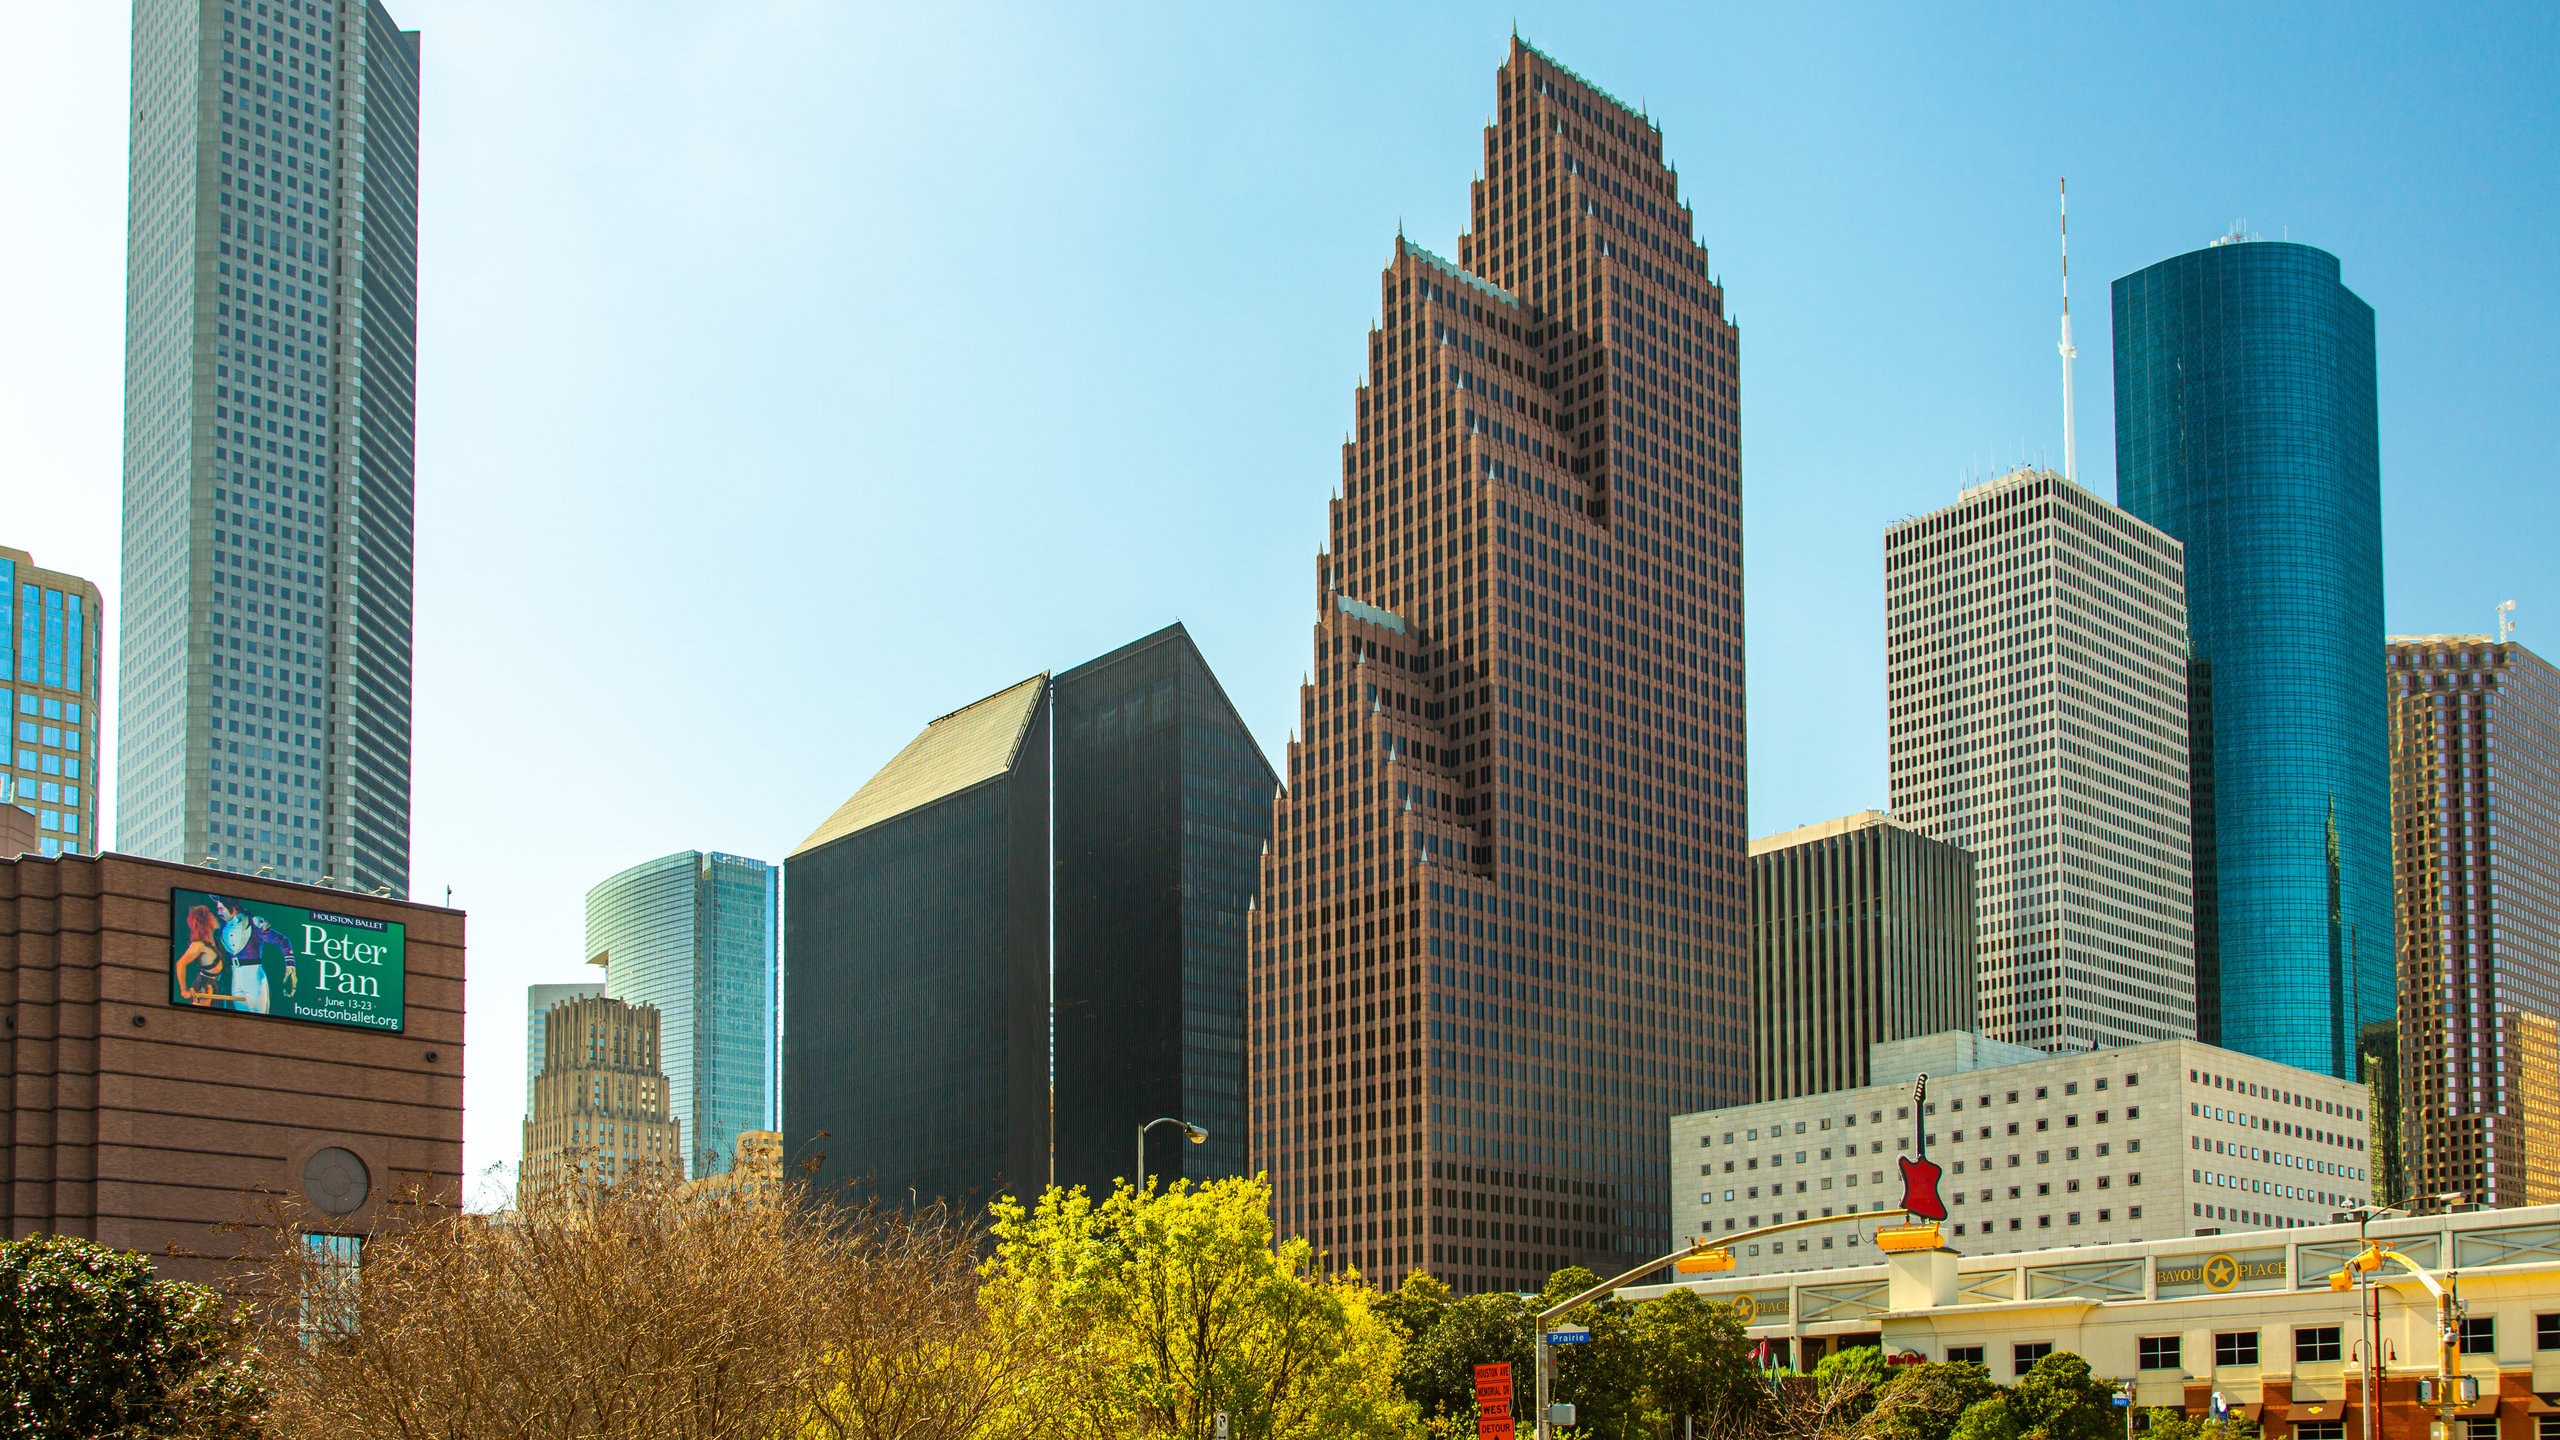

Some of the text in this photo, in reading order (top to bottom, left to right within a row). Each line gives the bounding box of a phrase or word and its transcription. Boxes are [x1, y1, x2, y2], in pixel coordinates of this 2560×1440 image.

[313, 912, 384, 930] HOUSTON BALLET
[300, 923, 388, 966] Peter
[315, 958, 381, 998] Pan
[324, 996, 373, 1011] June 13-23
[294, 1002, 398, 1030] houstonballet.org
[2157, 1261, 2287, 1284] BAYOU PLACE
[1552, 1333, 1584, 1343] Prairie
[1477, 1366, 1509, 1379] HOUSTON AVE
[1477, 1384, 1510, 1397] MEMORIAL DR
[1483, 1404, 1508, 1415] WEST
[1481, 1423, 1510, 1434] DETOUR
